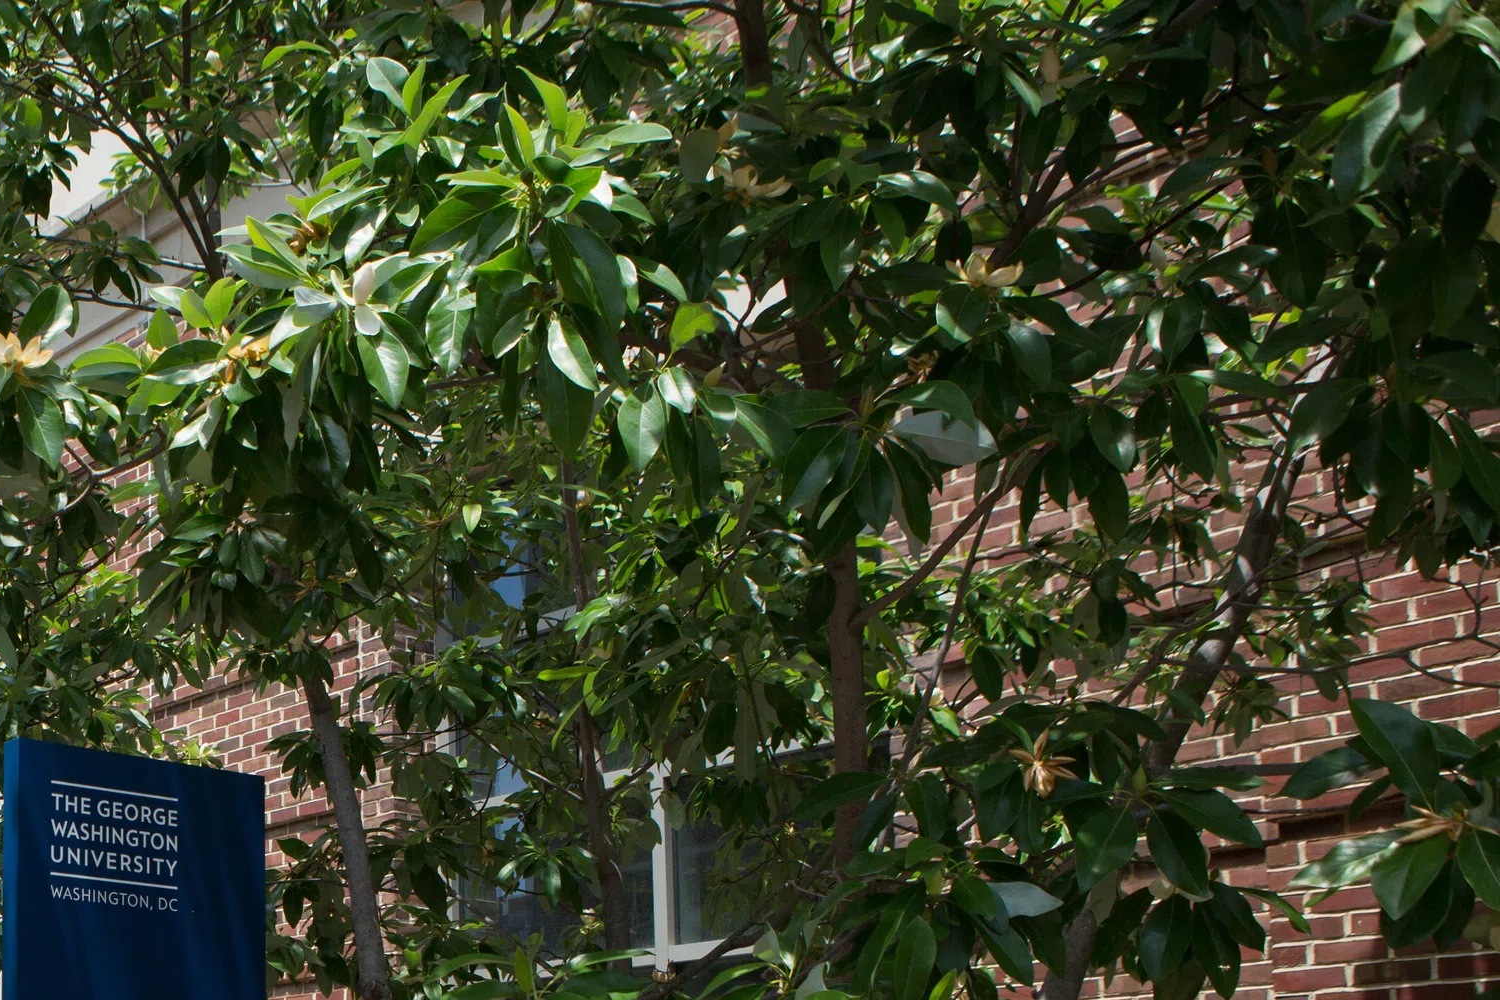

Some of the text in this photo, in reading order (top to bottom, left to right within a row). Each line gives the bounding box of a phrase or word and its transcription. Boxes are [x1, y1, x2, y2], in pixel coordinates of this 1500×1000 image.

[51, 793, 178, 827] THE GEORGE
[51, 819, 178, 853] WASHINGTON
[50, 844, 178, 877] UNIVERSITY
[50, 884, 178, 912] WASHINGTON, DC
